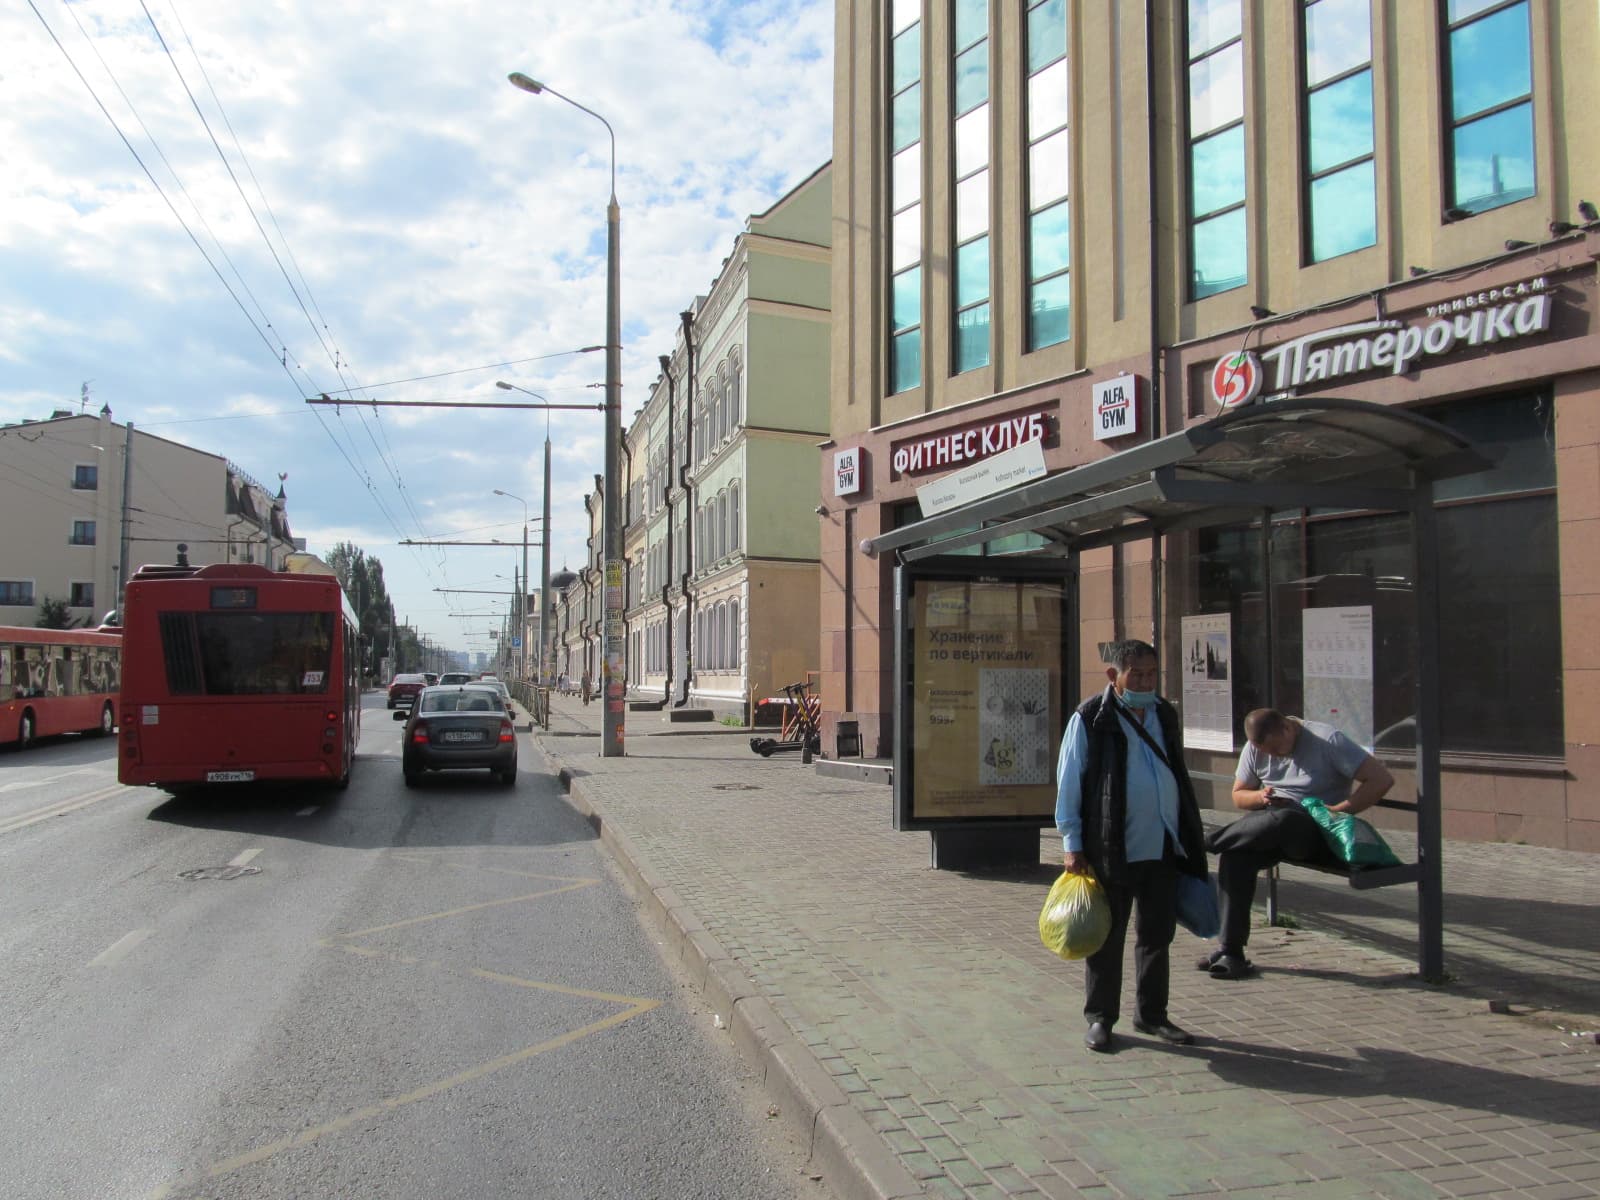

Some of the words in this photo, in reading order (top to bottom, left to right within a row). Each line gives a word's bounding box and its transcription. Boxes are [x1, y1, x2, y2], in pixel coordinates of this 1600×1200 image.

[1426, 278, 1546, 318] УНИВЕРСАМ
[1262, 294, 1552, 389] Пятёрочка
[1102, 386, 1124, 406] ALFA
[1102, 407, 1126, 429] GYM
[893, 430, 977, 473] ФИТНЕС
[982, 412, 1044, 455] КЛУБ
[840, 455, 853, 470] ALFA
[840, 471, 854, 488] GYM
[929, 630, 1003, 647] Хранение
[929, 651, 949, 660] по
[953, 650, 1033, 664] вертикали
